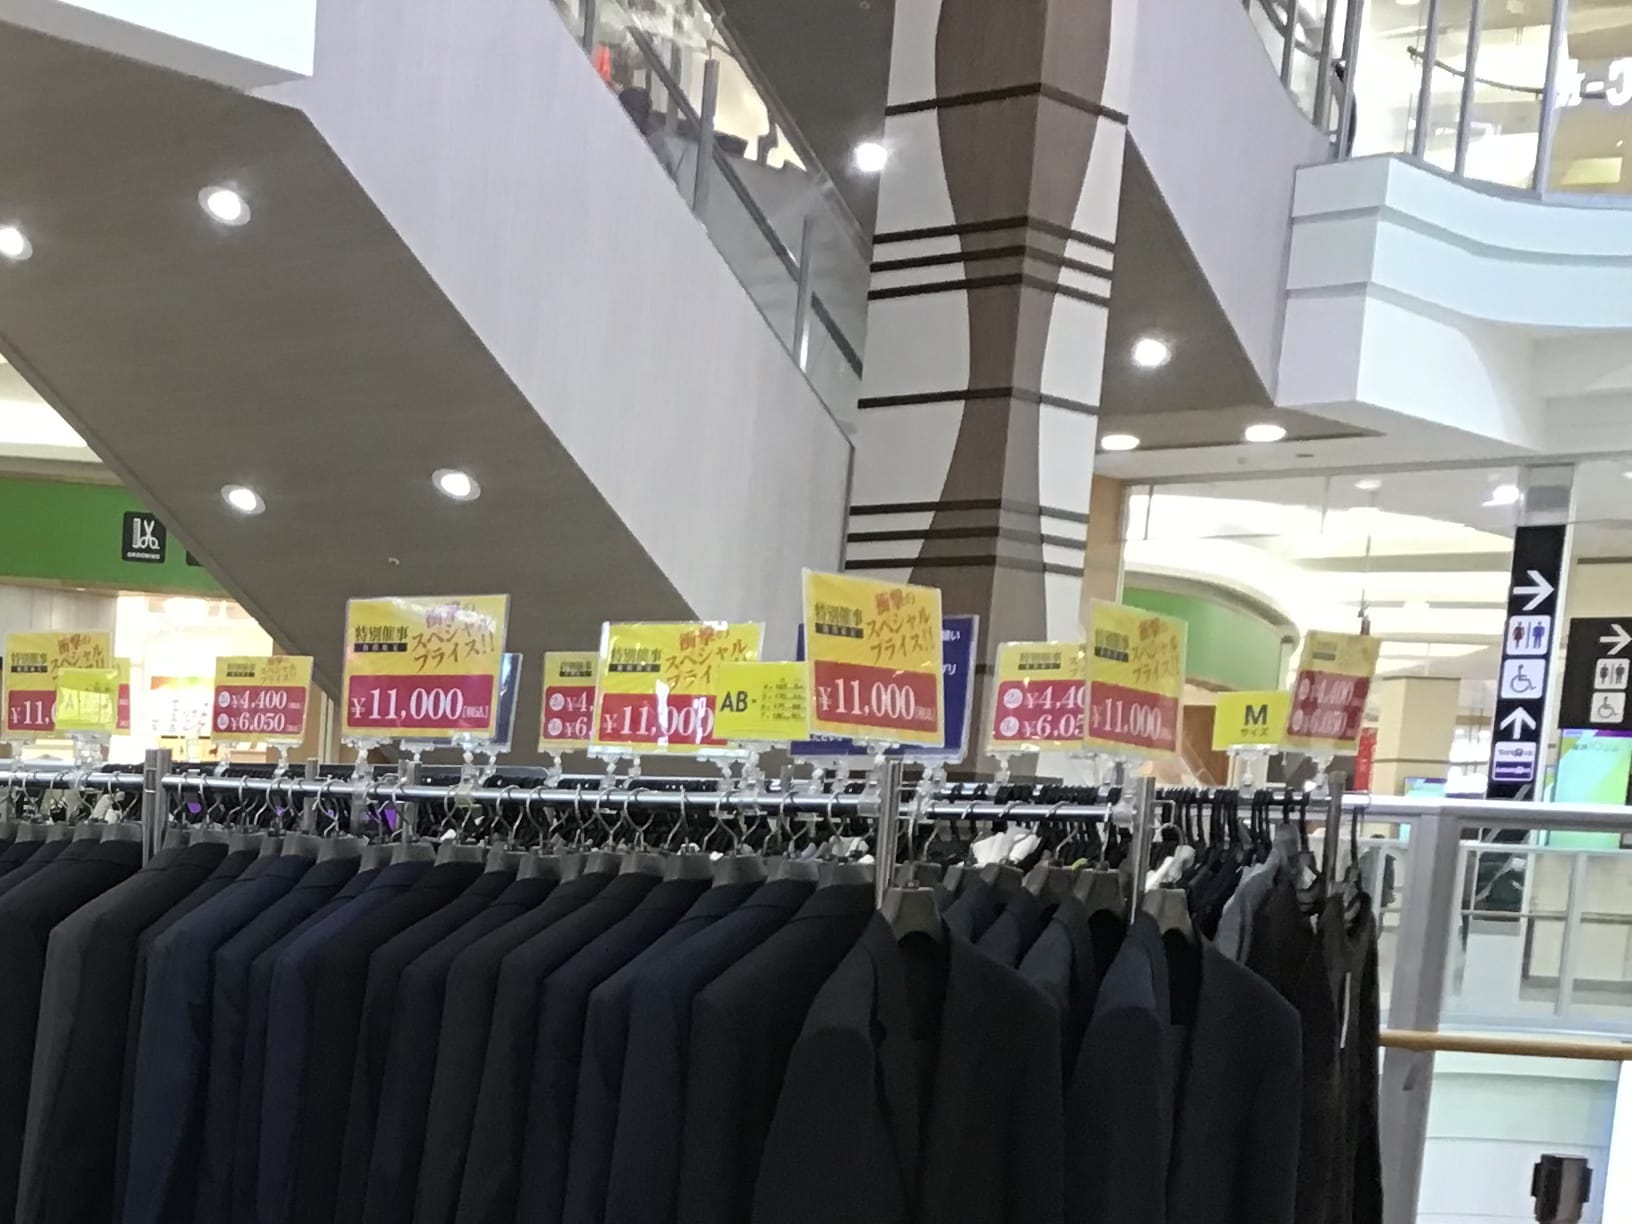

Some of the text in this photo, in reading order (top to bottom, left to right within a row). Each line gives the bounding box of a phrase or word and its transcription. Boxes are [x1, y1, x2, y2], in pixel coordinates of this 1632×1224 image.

[351, 686, 464, 721] ¥11,000
[818, 678, 916, 720] ¥11,000
[1244, 704, 1269, 726] M
